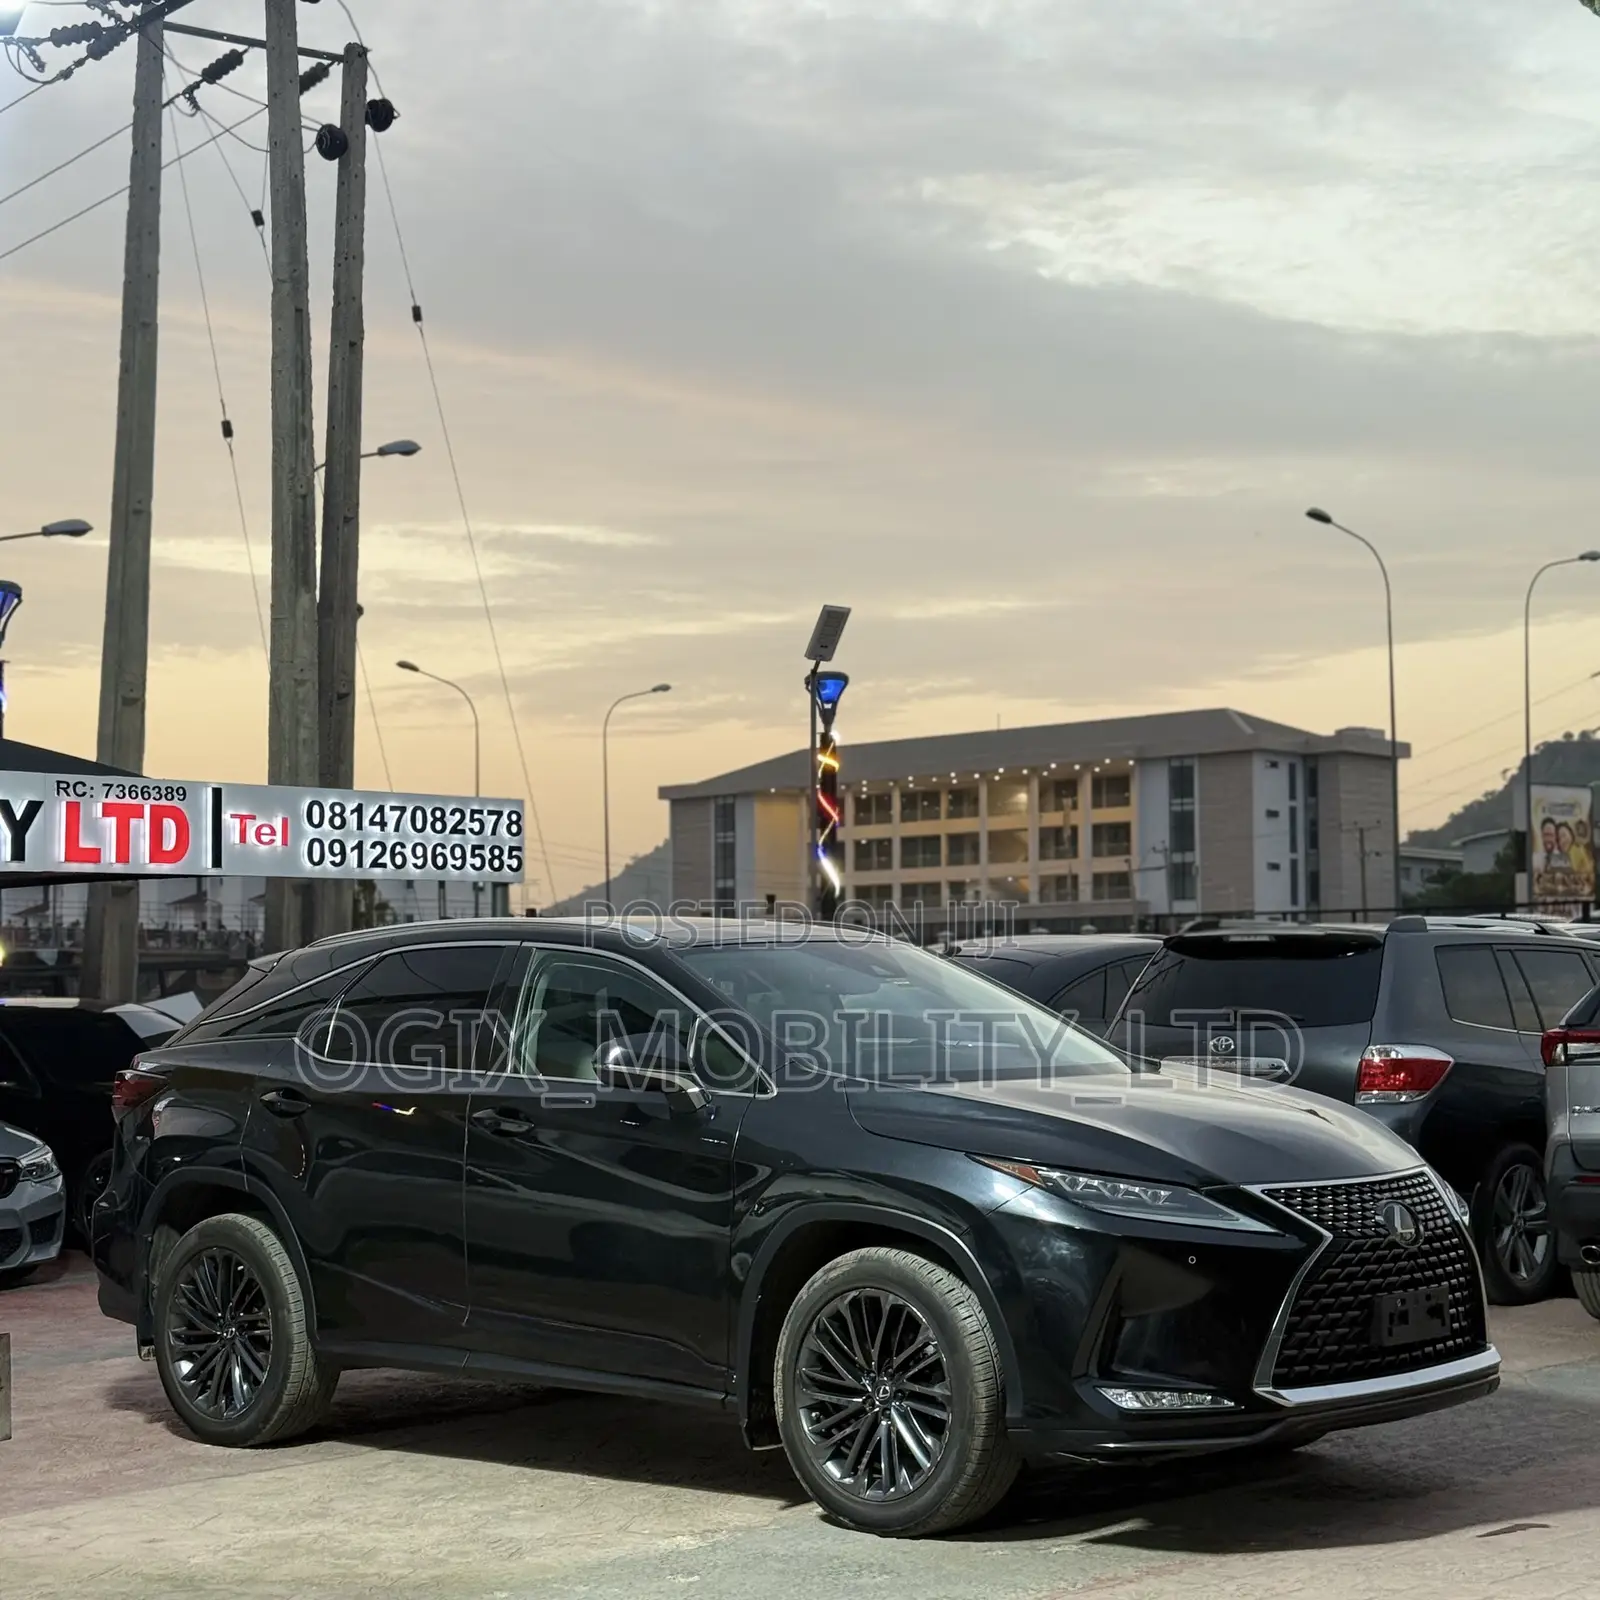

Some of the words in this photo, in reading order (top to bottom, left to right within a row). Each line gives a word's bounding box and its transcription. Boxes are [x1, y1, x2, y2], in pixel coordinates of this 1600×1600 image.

[56, 780, 94, 799] RC:
[102, 783, 187, 801] 7366389
[62, 801, 190, 864] LTD
[228, 812, 289, 847] Tel
[306, 799, 523, 837] 08147082578
[307, 837, 524, 873] 09126969585
